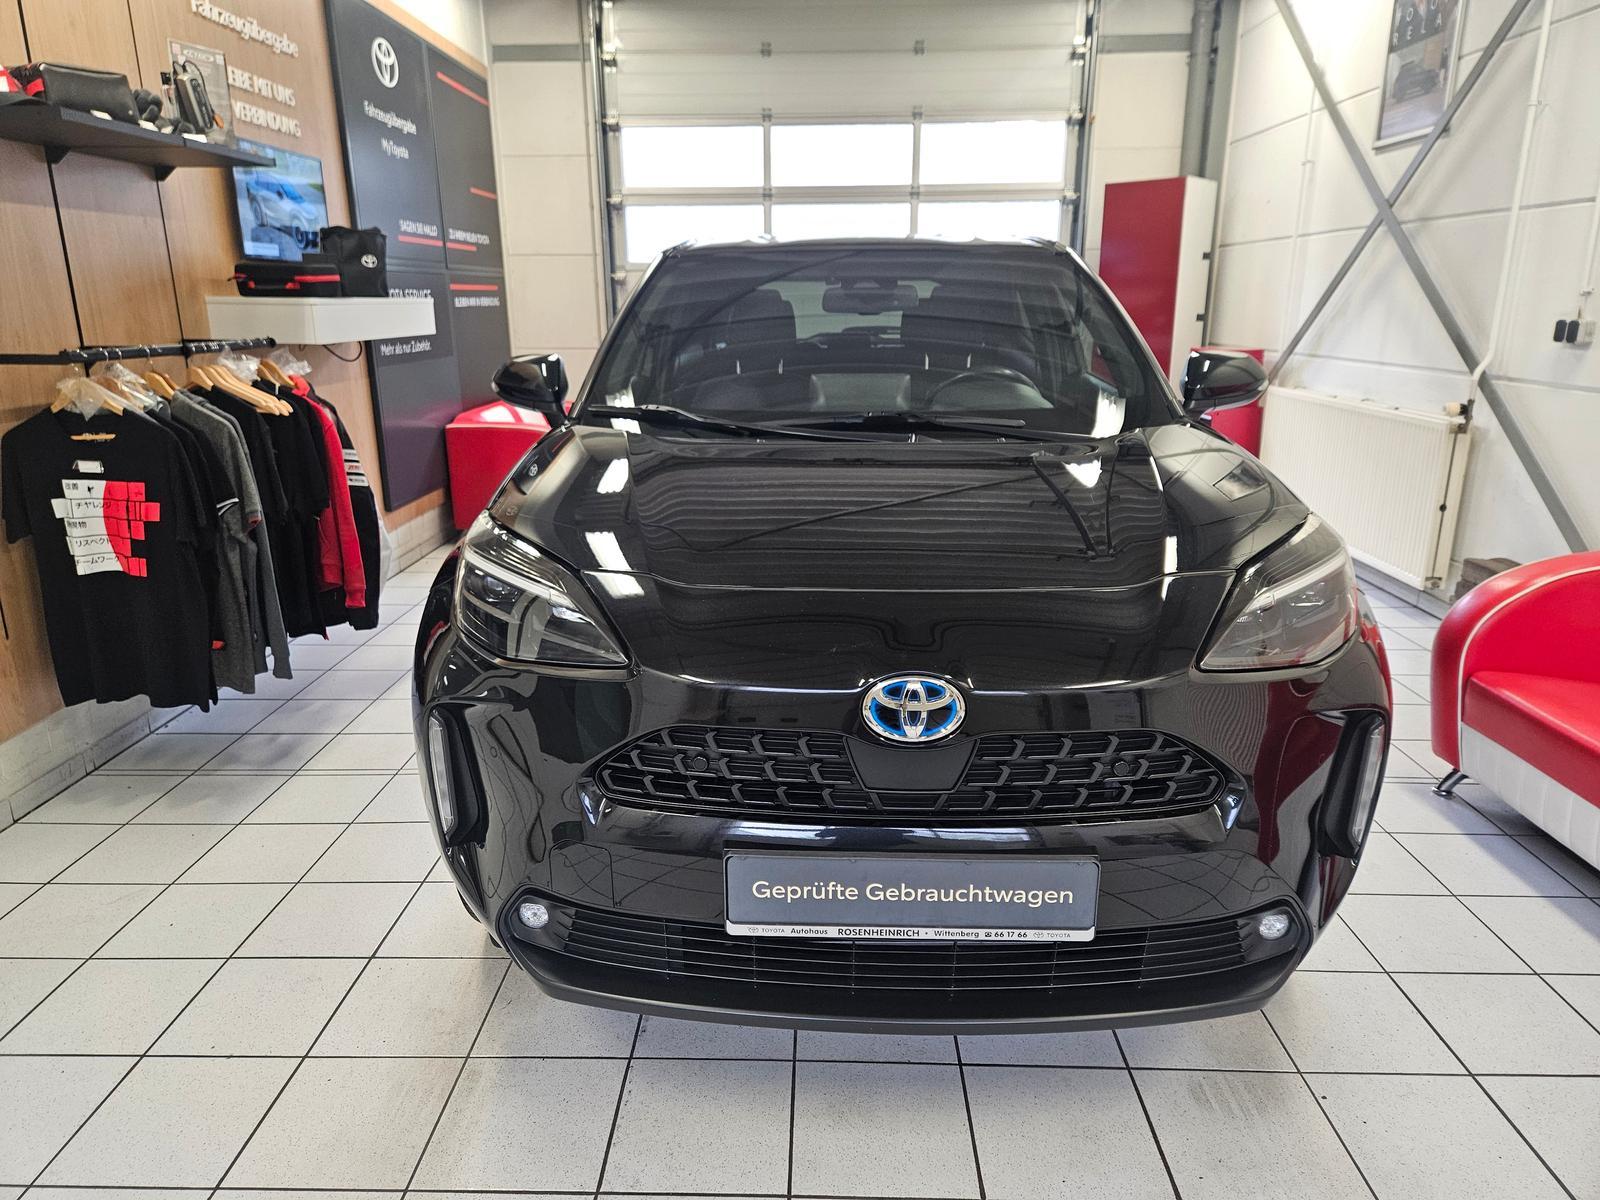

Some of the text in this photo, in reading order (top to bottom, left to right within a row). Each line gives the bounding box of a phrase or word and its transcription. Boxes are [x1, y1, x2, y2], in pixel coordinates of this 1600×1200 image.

[380, 344, 394, 356] Mehr
[395, 342, 403, 354] als
[403, 345, 411, 354] nur
[752, 880, 1074, 908] Geprüfte Gebrauchtwagen
[790, 927, 828, 935] Autohaus
[837, 928, 920, 938] ROSENHEINRICH
[934, 929, 980, 939] Wittenberg
